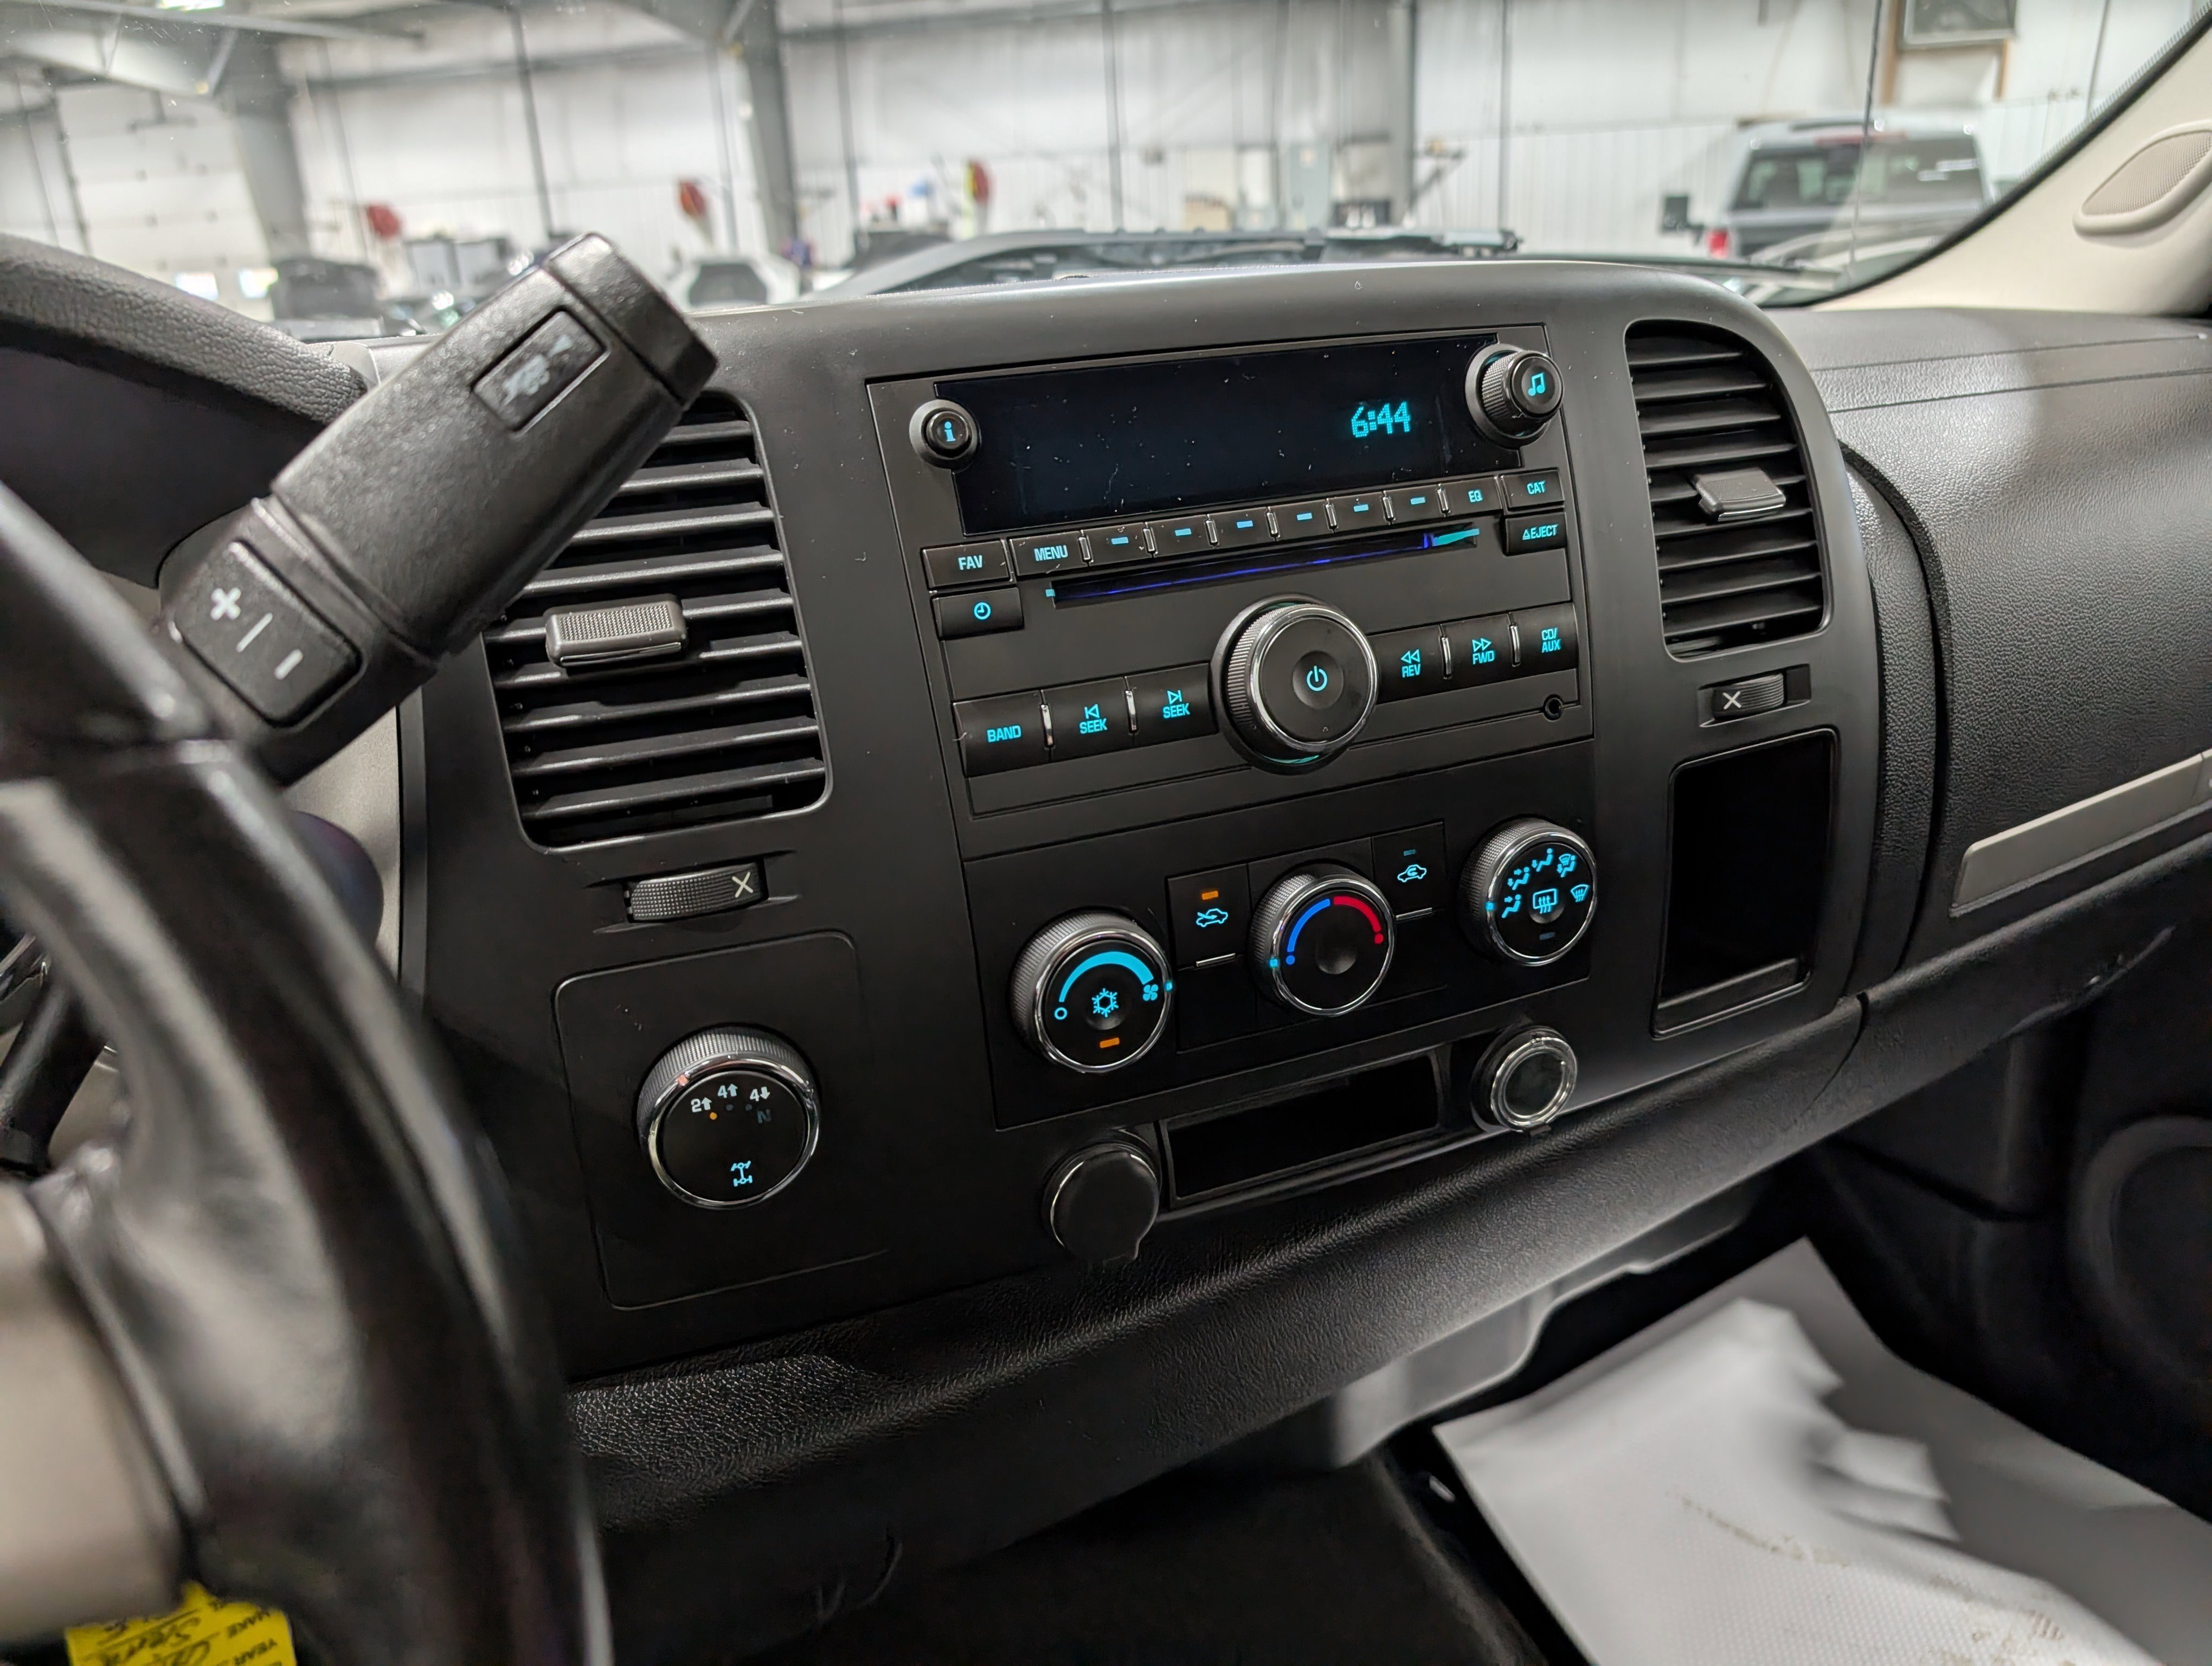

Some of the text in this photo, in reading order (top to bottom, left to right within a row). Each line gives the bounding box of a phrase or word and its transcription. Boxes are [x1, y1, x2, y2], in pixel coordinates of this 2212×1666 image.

[1351, 401, 1411, 438] 6:44
[1526, 480, 1546, 495] CAT
[1468, 489, 1483, 503] EQ
[1530, 523, 1558, 539] EJECT
[1033, 544, 1068, 561] MENU
[958, 555, 983, 570] FAV
[1541, 627, 1557, 641] CD/
[1541, 638, 1561, 653] AUX
[1472, 650, 1496, 664] FWD
[1401, 663, 1421, 678] REV
[1162, 702, 1191, 719] SEEK
[986, 725, 1021, 742] BAND
[1079, 718, 1108, 734] SEEK
[232, 1638, 278, 1665] YEAR
